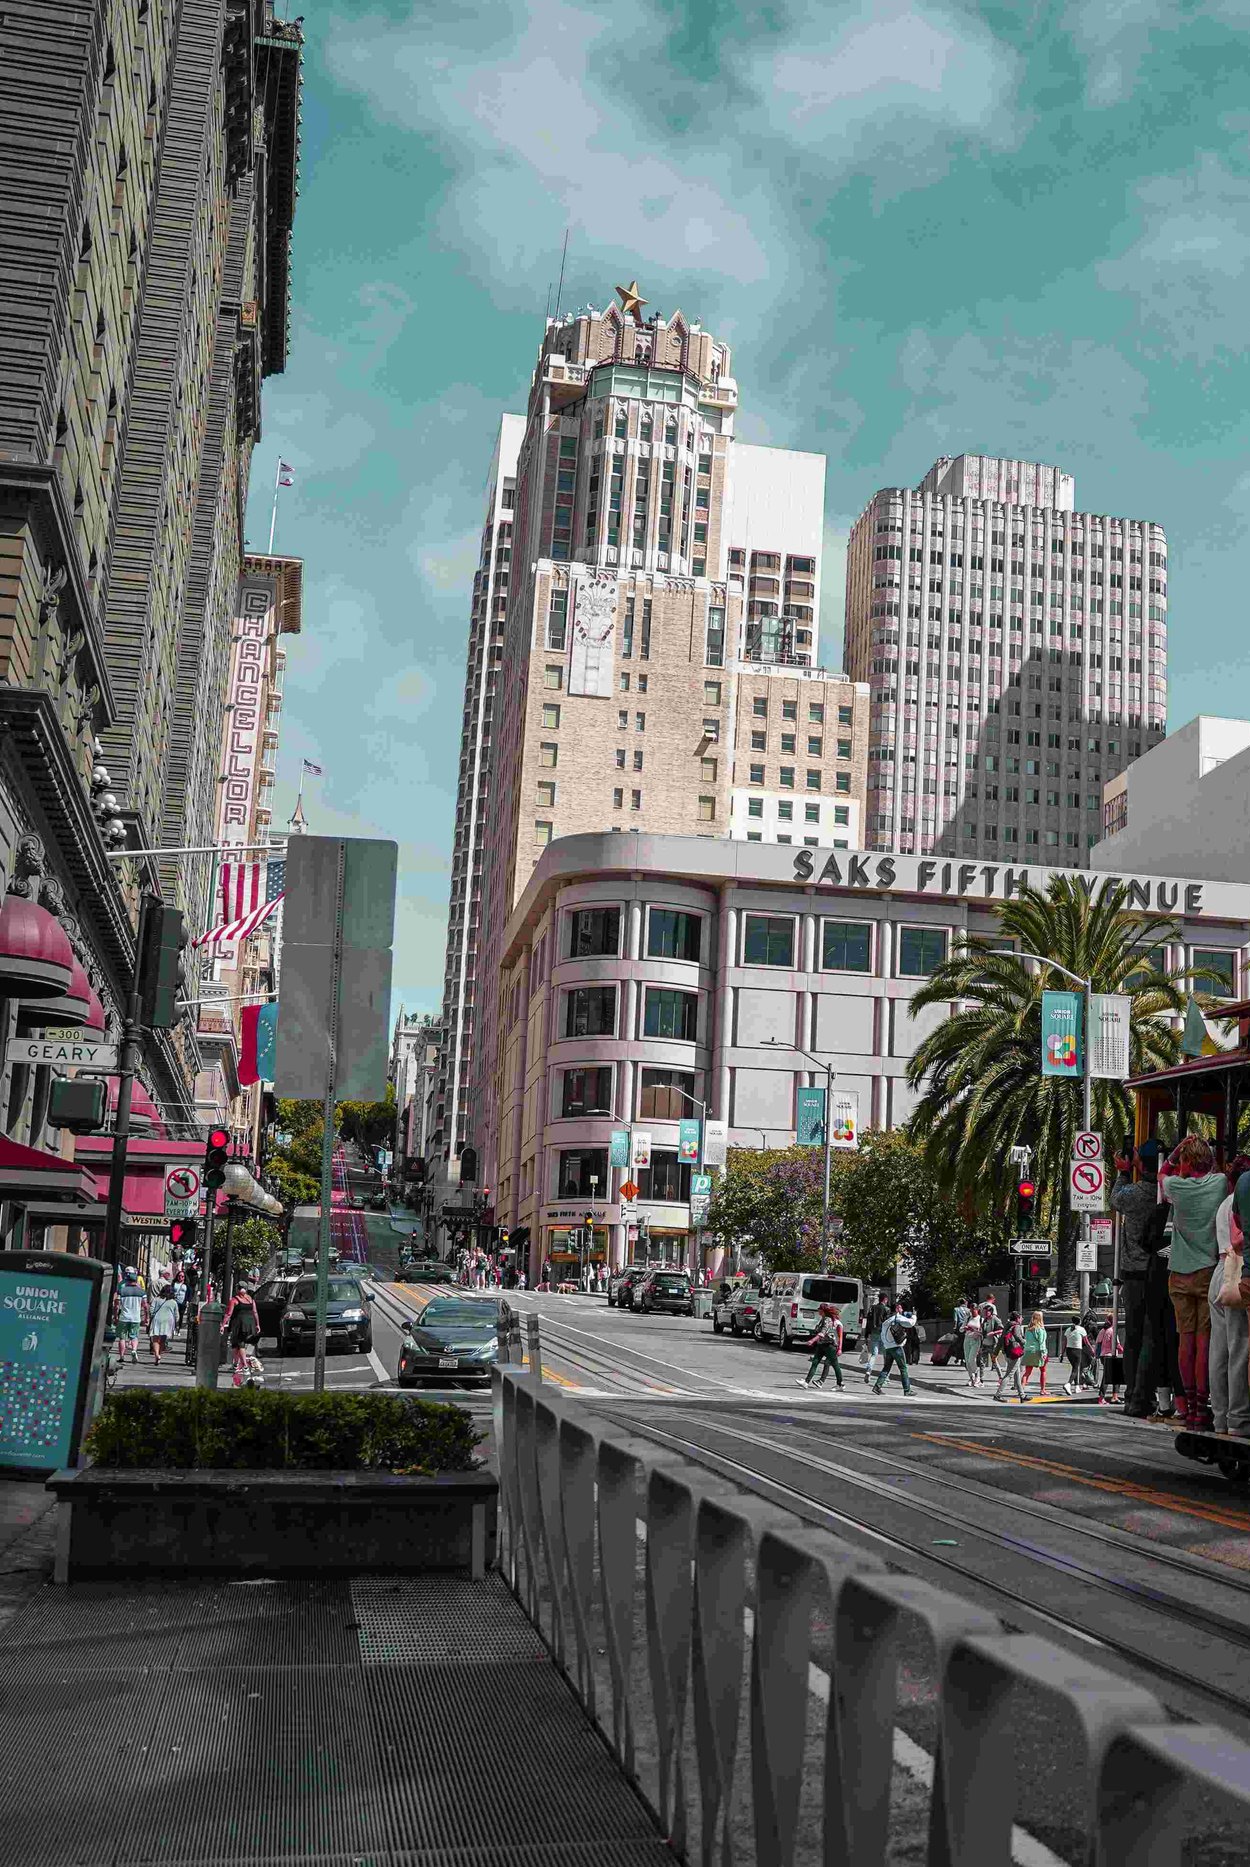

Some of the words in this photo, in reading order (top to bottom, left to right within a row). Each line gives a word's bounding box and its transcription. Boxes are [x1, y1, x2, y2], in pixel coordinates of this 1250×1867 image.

[221, 587, 272, 826] CHANCELLOR
[793, 850, 897, 888] SAKS
[917, 859, 1029, 898] FIFTH
[58, 1030, 80, 1040] 300
[27, 1045, 98, 1061] GEARY
[131, 1216, 161, 1225] WESTIN
[163, 1217, 169, 1225] S
[15, 1286, 59, 1299] UNION
[3, 1296, 67, 1315] SQUARE
[18, 1313, 50, 1322] ALLIANCE
